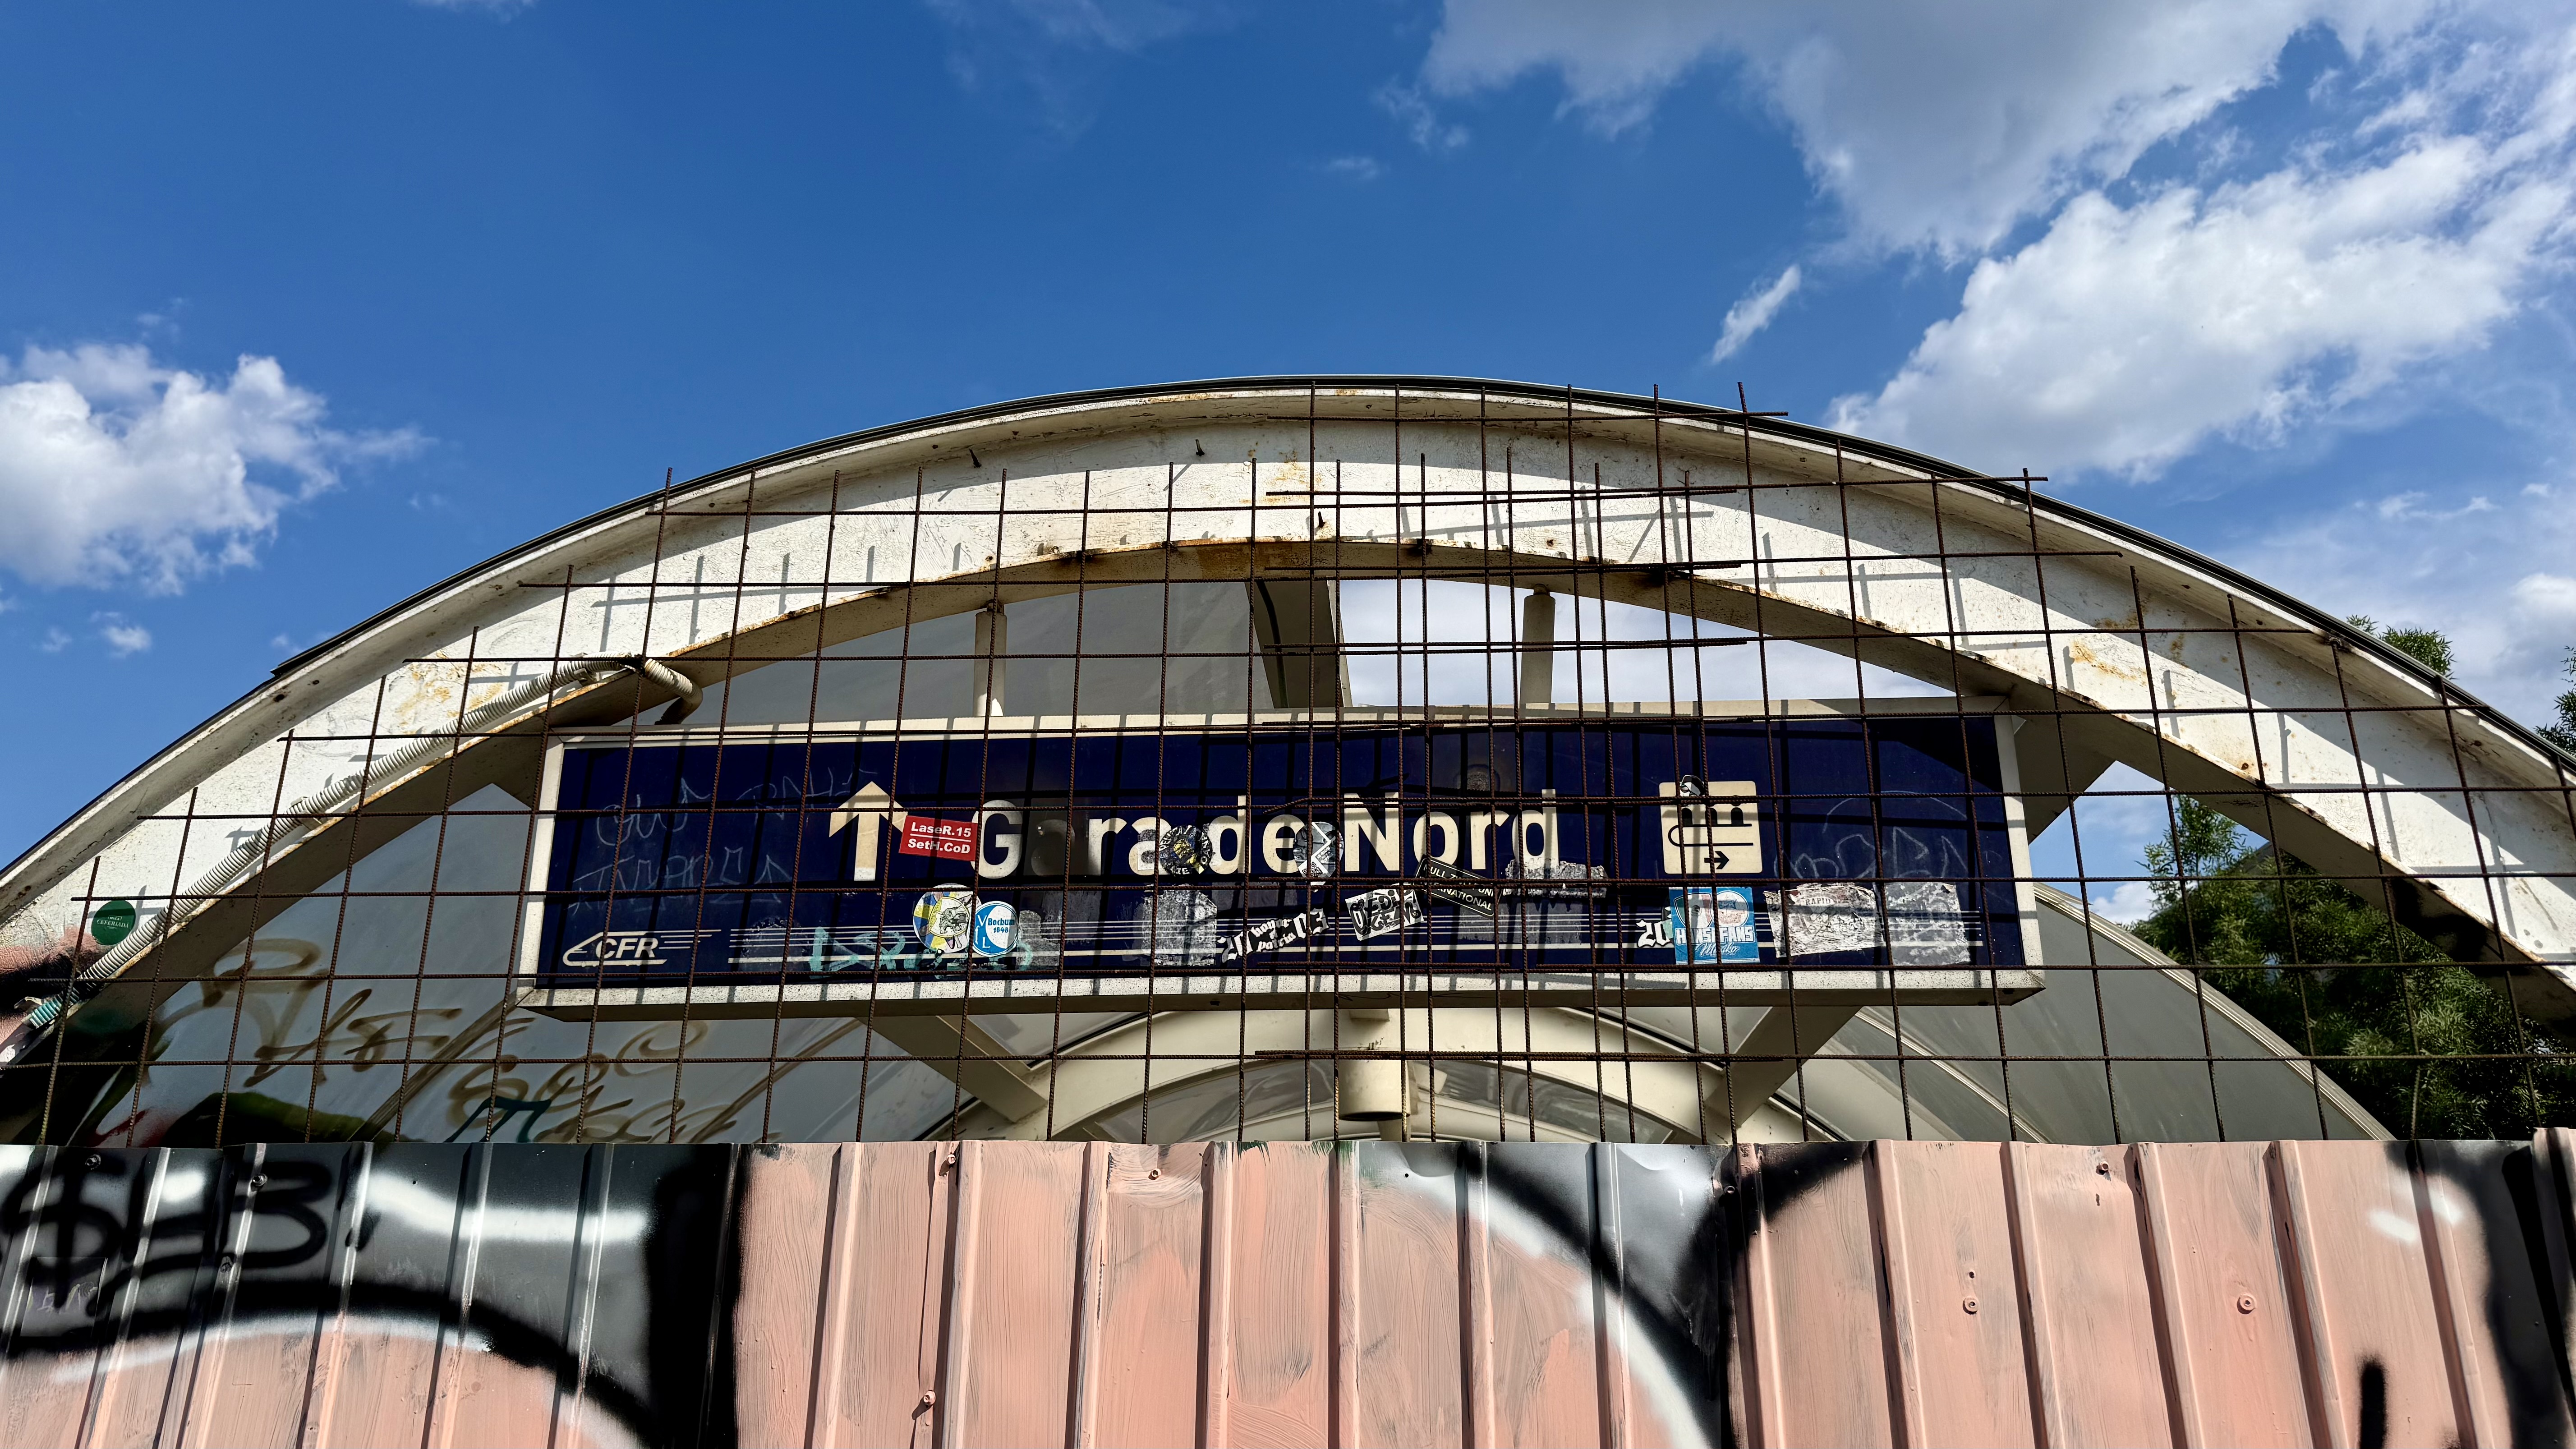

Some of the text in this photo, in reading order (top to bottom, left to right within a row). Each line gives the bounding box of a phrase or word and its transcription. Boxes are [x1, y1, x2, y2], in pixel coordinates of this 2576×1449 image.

[911, 822, 971, 837] LaseR.15
[971, 800, 1173, 879] Gara
[1208, 795, 1305, 874] de
[1344, 789, 1559, 871] Nord
[907, 838, 971, 854] SetH.CoD
[1805, 897, 1831, 906] RAPID
[988, 918, 1015, 926] Bochum
[595, 938, 659, 959] CFR
